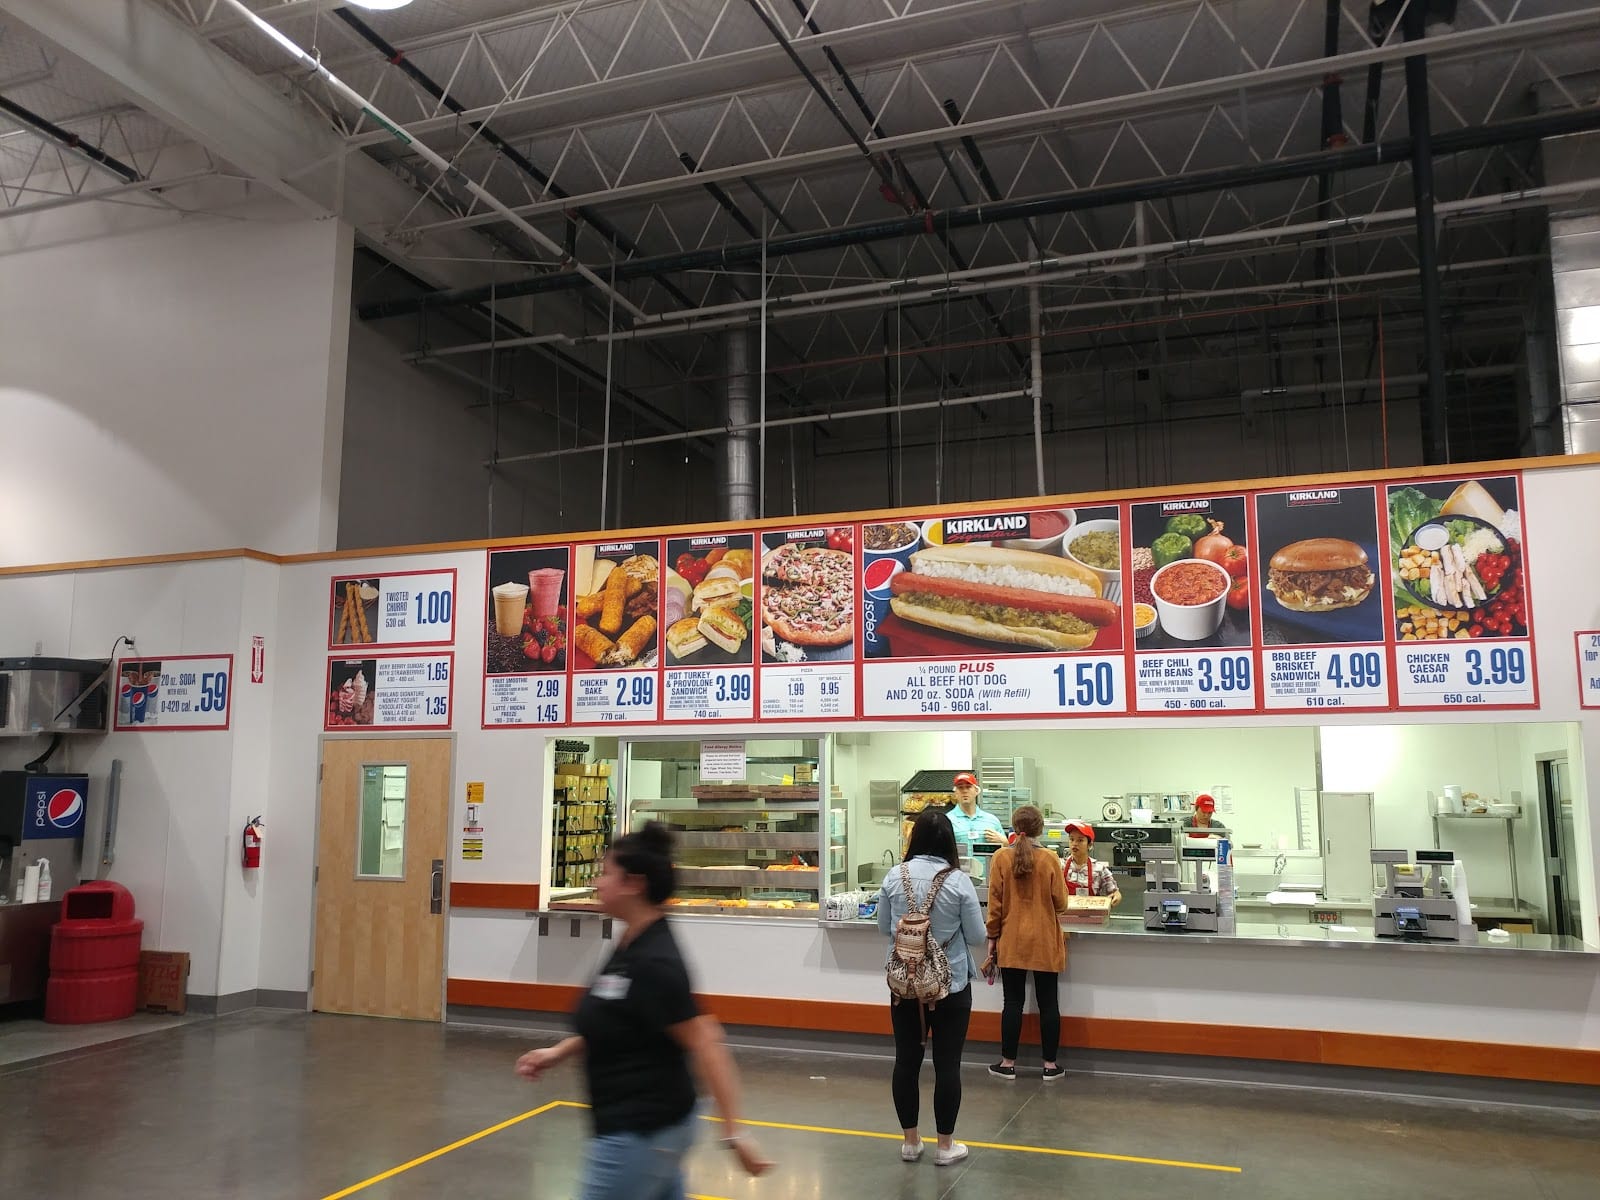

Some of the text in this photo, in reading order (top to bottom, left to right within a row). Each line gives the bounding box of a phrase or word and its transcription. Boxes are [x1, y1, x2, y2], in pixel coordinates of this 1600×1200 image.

[1290, 491, 1338, 501] KIRKLAND
[1163, 501, 1209, 511] KIRKLAND
[946, 516, 1027, 534] KIRKLAND
[787, 530, 824, 539] KIRKLAND
[947, 531, 1022, 543] Signature
[692, 537, 726, 546] KIRKLAND
[600, 544, 633, 552] KIRKLAND
[386, 592, 409, 601] TWISTED
[387, 602, 408, 612] CHURRO
[416, 591, 451, 624] 1.00
[864, 600, 878, 643] pepsi
[1272, 652, 1317, 662] BBQ BEEF
[1407, 653, 1450, 664] CHICKEN
[1585, 650, 1599, 662] for
[928, 666, 956, 674] POUND
[959, 663, 995, 673] PLUS
[1142, 659, 1189, 668] BEEF CHILI
[1276, 662, 1315, 671] BRISKET
[1409, 664, 1449, 674] CAESAR
[1465, 648, 1526, 686] 3.99
[427, 663, 448, 681] 1.65
[669, 672, 681, 680] HOT
[1139, 668, 1193, 678] WITH BEANS
[1198, 657, 1250, 692] 3.99
[1327, 652, 1381, 689] 4.99
[161, 674, 170, 686] 20
[179, 673, 196, 686] SODA
[907, 674, 1007, 687] ALL BEEF HOT DOG
[1271, 671, 1320, 682] SANDWICH
[1413, 674, 1446, 684] SALAD
[580, 679, 608, 687] CHICKEN
[674, 679, 714, 687] PROVOLONE
[716, 674, 751, 701] 3.99
[821, 682, 840, 695] 9.95
[1053, 662, 1113, 706] 1.50
[195, 672, 228, 712] .59
[537, 680, 559, 698] 2.99
[616, 676, 654, 706] 2.99
[672, 687, 708, 696] SANDWICH
[788, 683, 805, 696] 1.99
[886, 688, 1031, 700] AND 20 oz. SODA (With Refill)
[1165, 700, 1181, 709] 450
[1190, 700, 1207, 708] 600
[1210, 699, 1226, 708] cal.
[1306, 697, 1345, 706] 610 cal.
[1444, 693, 1486, 704] 650 cal.
[426, 697, 447, 715] 1.35
[921, 702, 940, 712] 540
[952, 701, 970, 712] 960
[974, 700, 992, 711] cal.
[537, 705, 558, 722] 1.45
[694, 710, 722, 718] 740 cal.
[36, 792, 47, 827] pepsi
